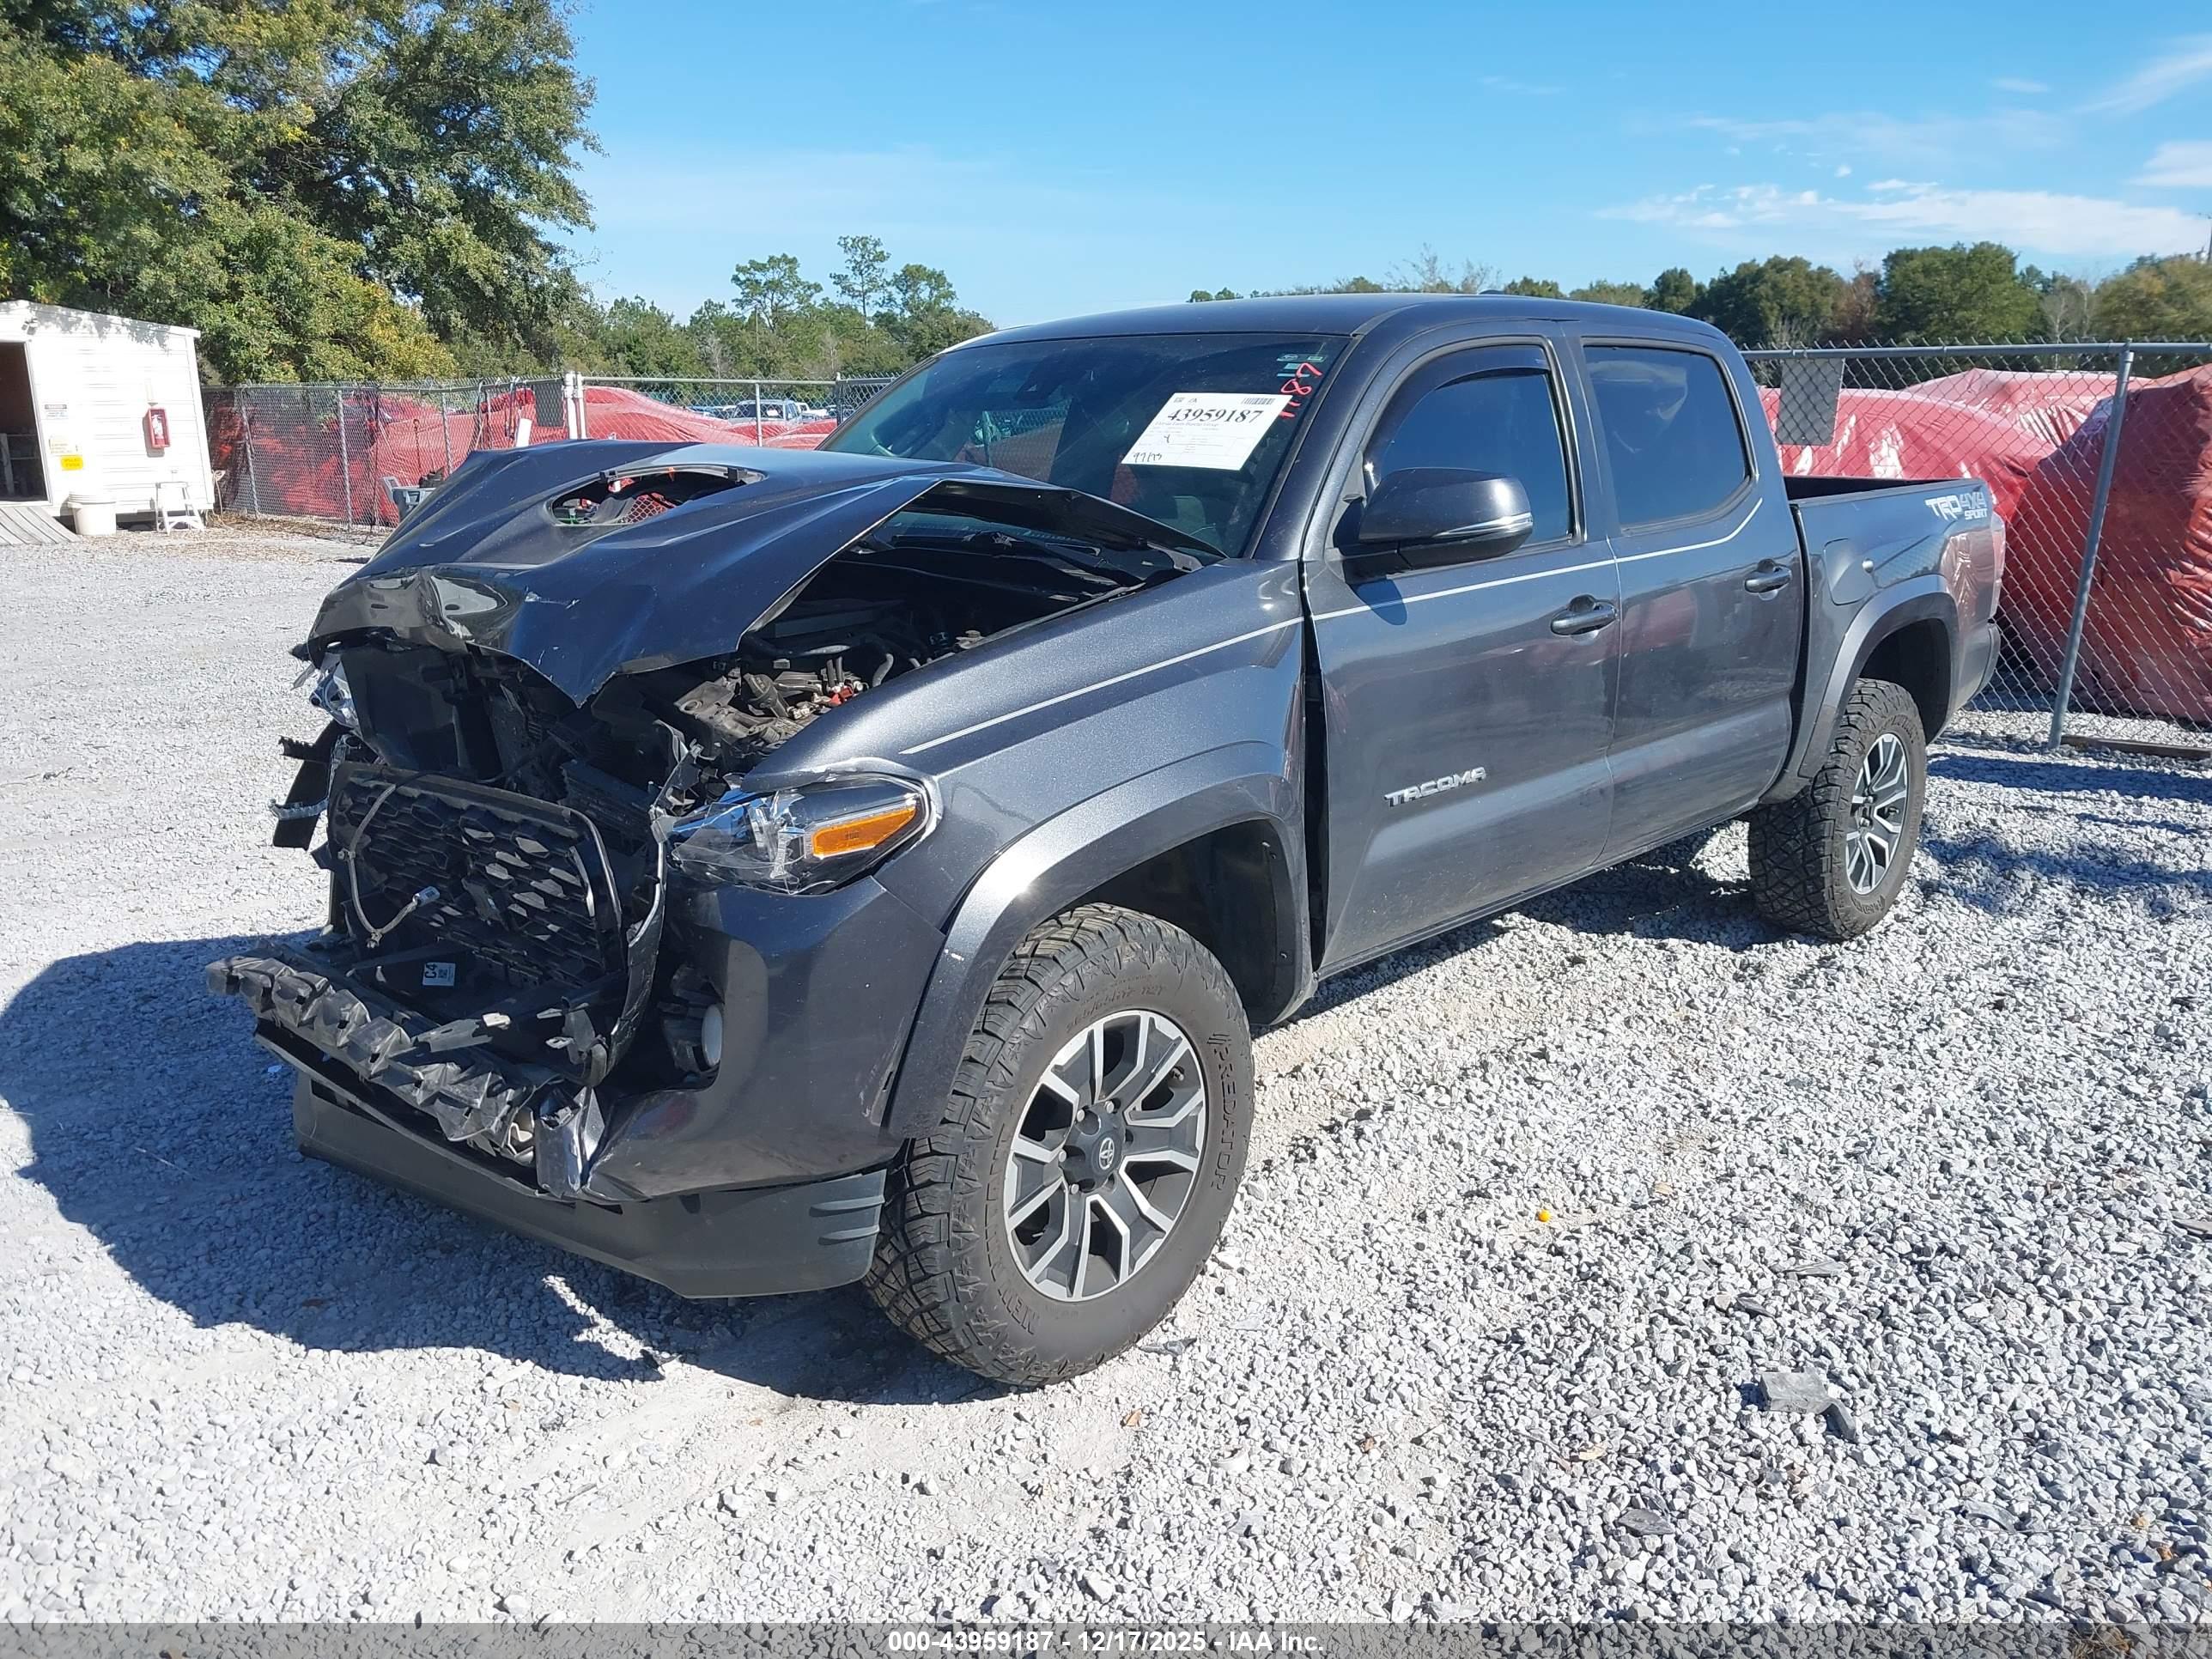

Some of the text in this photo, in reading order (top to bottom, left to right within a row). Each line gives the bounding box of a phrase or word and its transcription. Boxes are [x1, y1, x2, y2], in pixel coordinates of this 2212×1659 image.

[1167, 408, 1265, 423] 43959187
[1924, 495, 1963, 521] TRD
[1964, 507, 1988, 520] SPORT
[1383, 766, 1486, 806] TACOMA
[425, 963, 437, 979] C4
[1209, 1044, 1237, 1192] PREDATOR
